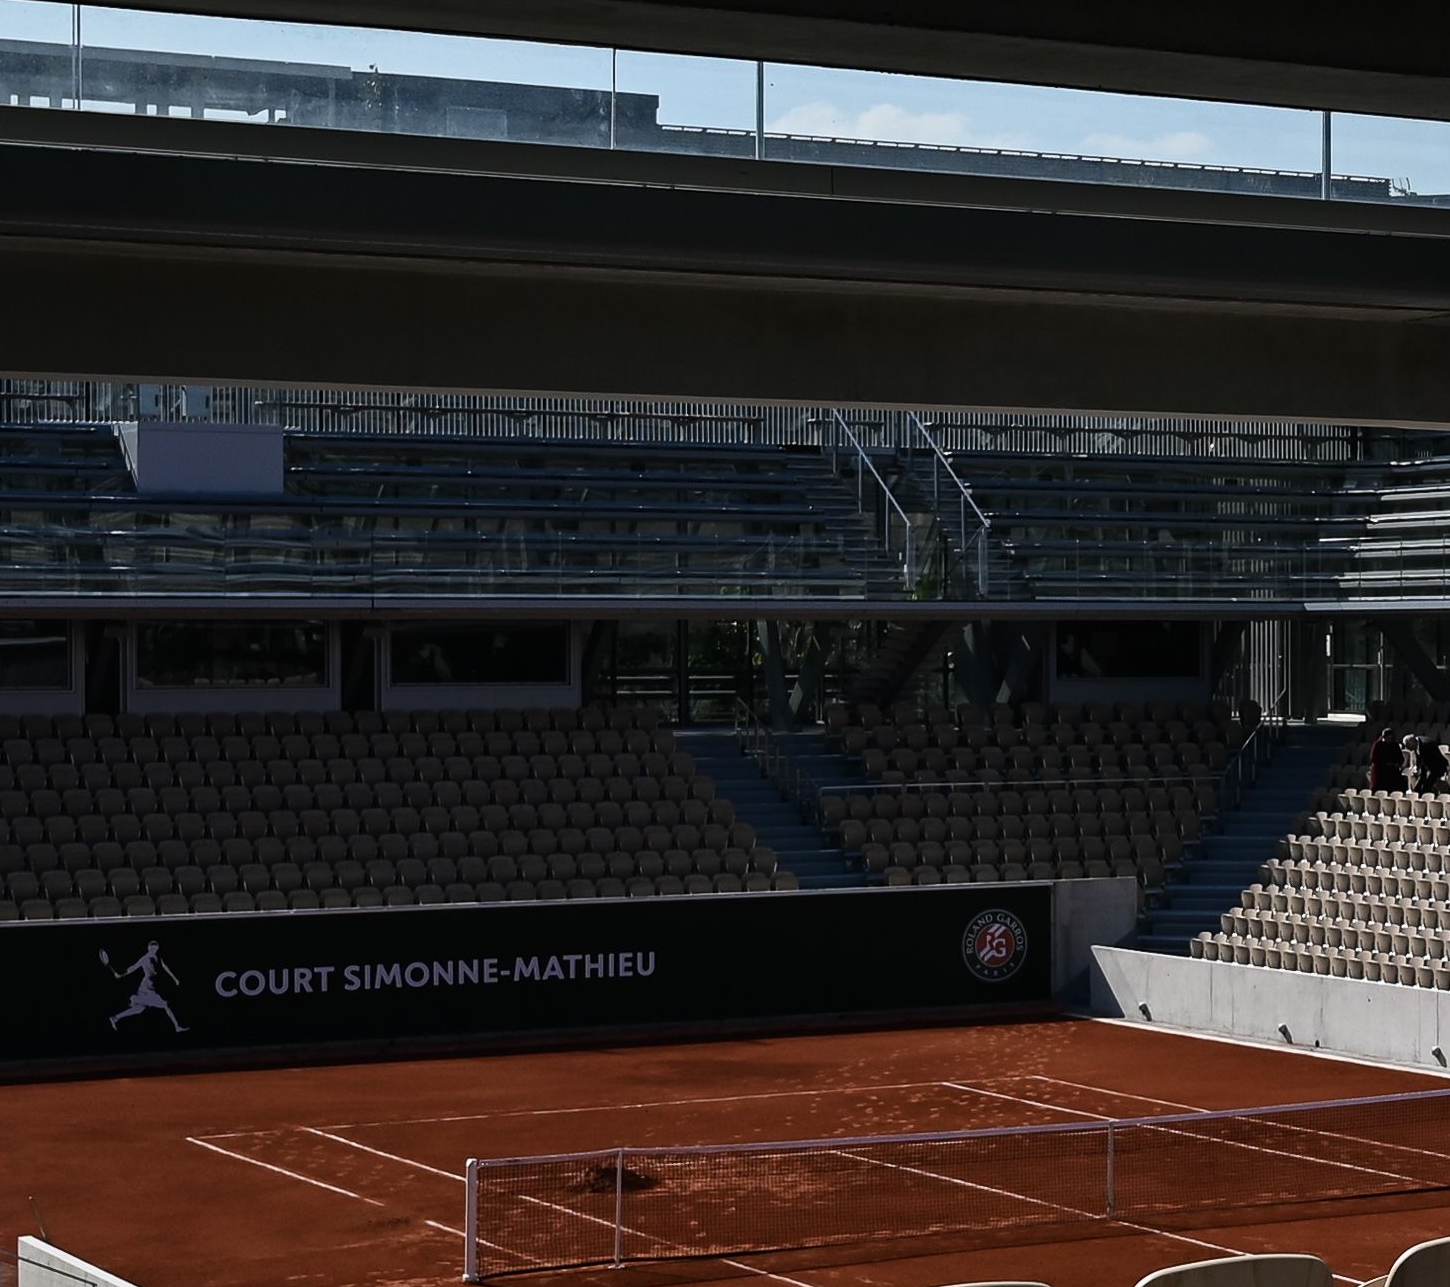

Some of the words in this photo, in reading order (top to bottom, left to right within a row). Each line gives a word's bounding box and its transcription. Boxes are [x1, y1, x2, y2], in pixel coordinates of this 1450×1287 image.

[966, 914, 993, 954] ROLAND
[996, 913, 1024, 951] GARROS
[215, 967, 334, 997] COURT
[344, 952, 655, 990] SIMONNE-MATHIEU
